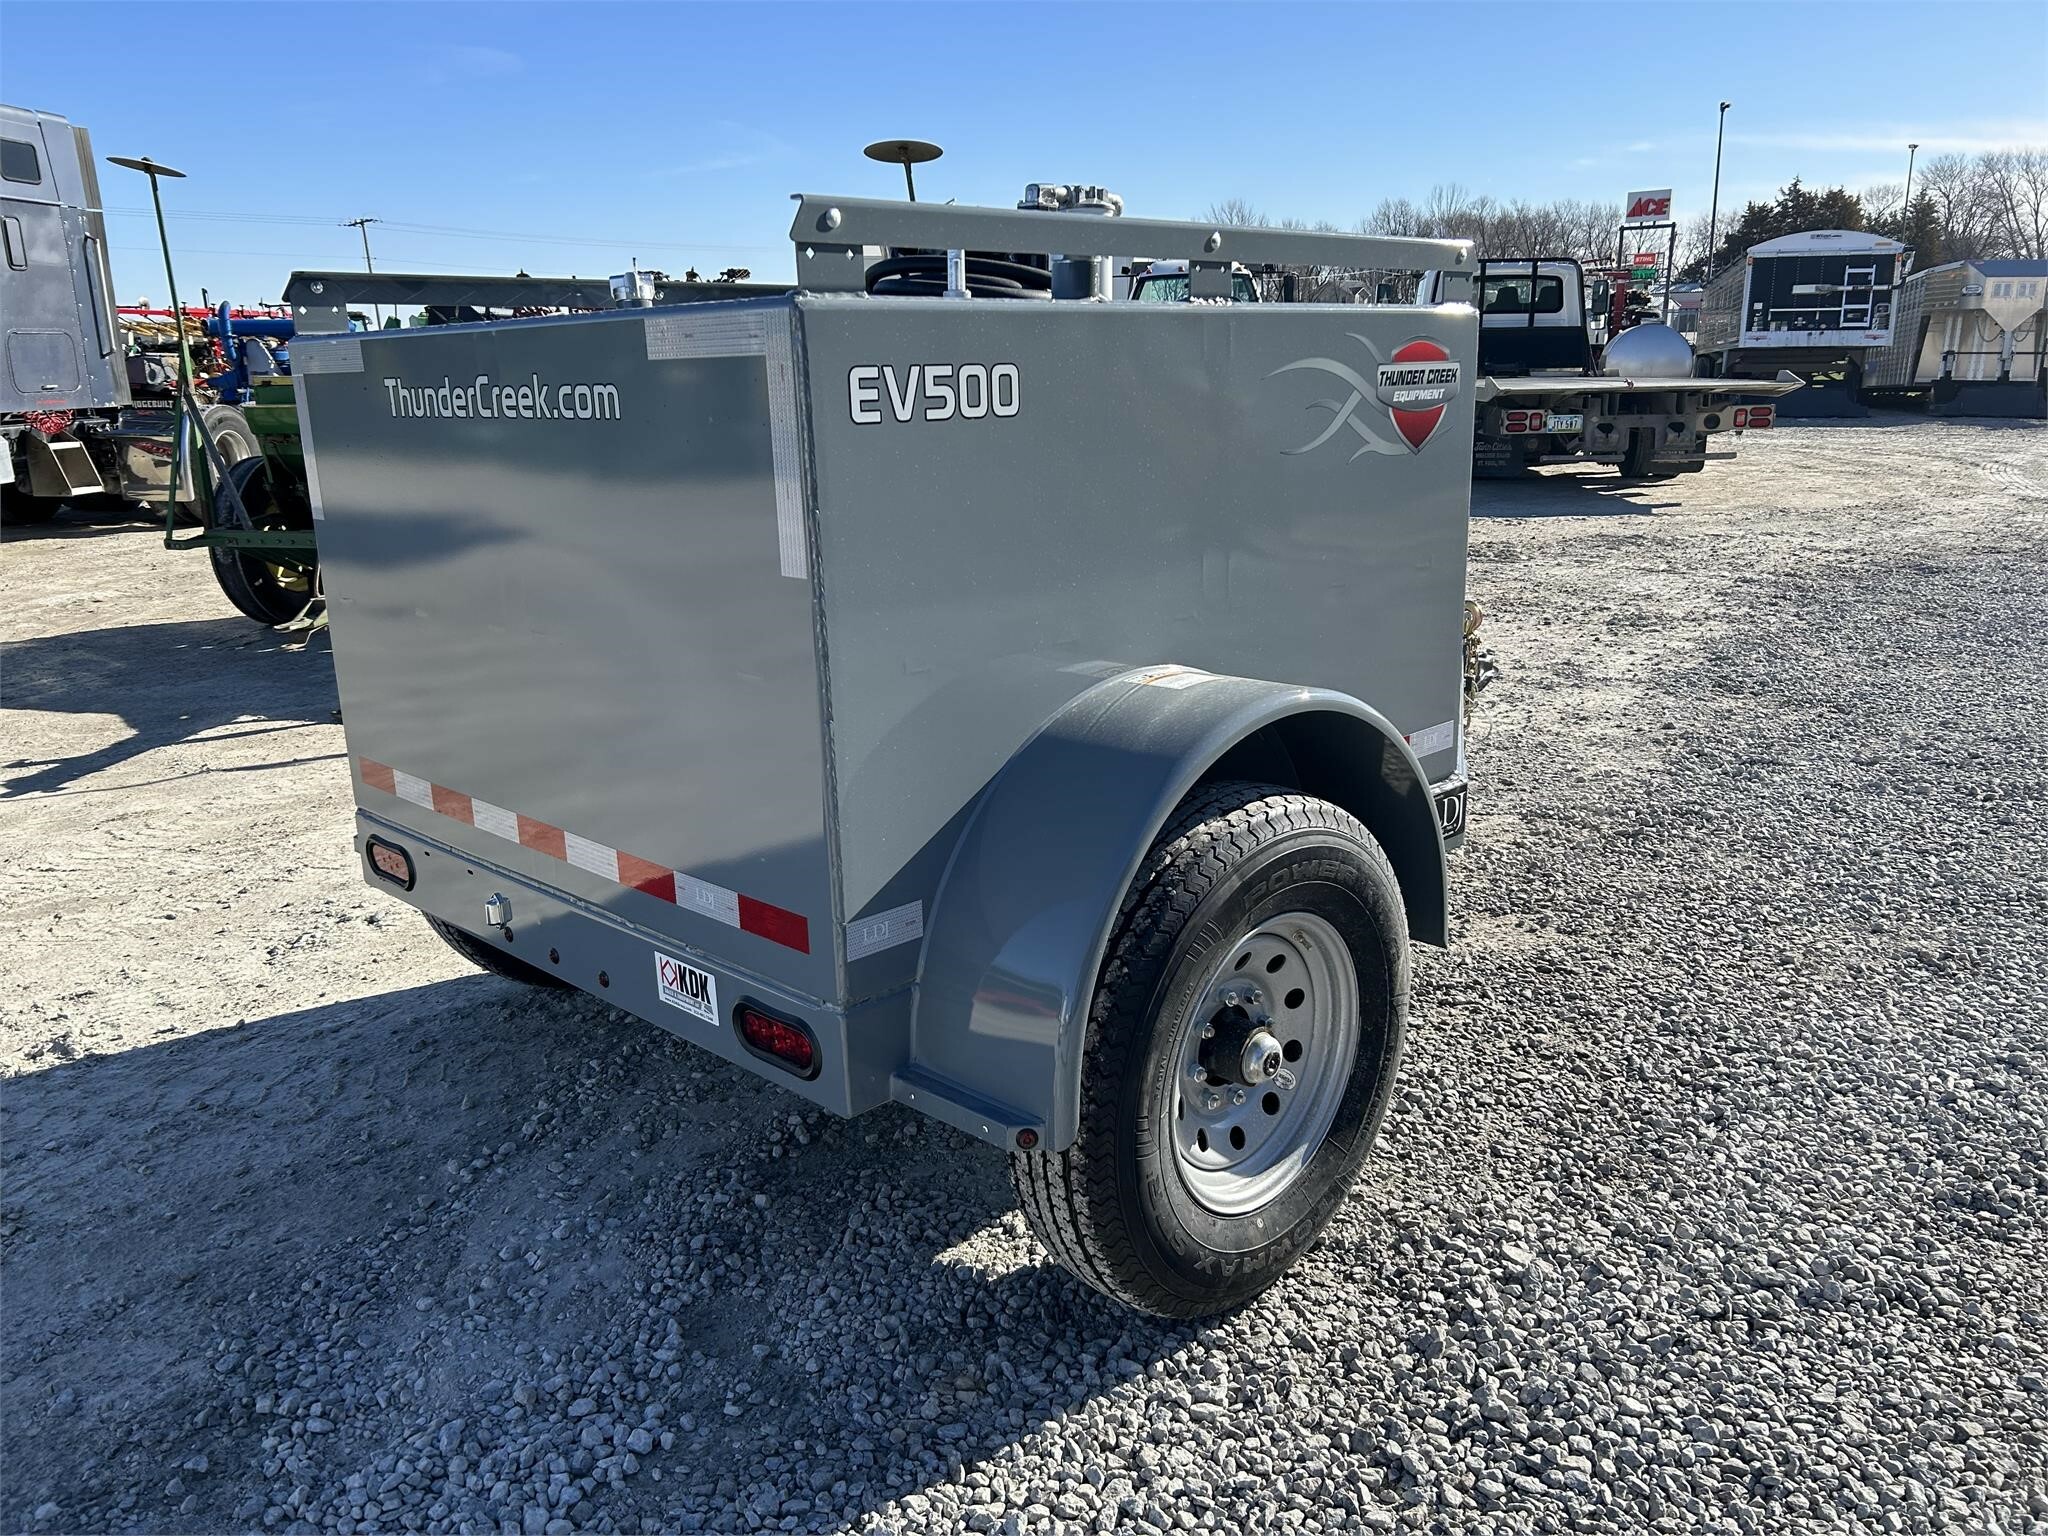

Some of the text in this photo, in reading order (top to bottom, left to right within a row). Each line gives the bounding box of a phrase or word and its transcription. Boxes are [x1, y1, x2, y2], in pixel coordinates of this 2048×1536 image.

[1626, 197, 1670, 217] ACE
[383, 373, 621, 420] ThunderCreek.com
[848, 363, 1020, 424] EV500
[1379, 368, 1458, 387] THUNDER CREEK
[1393, 389, 1445, 403] EQUIPMENT
[1243, 858, 1358, 908] POWER
[677, 963, 712, 1005] KDK
